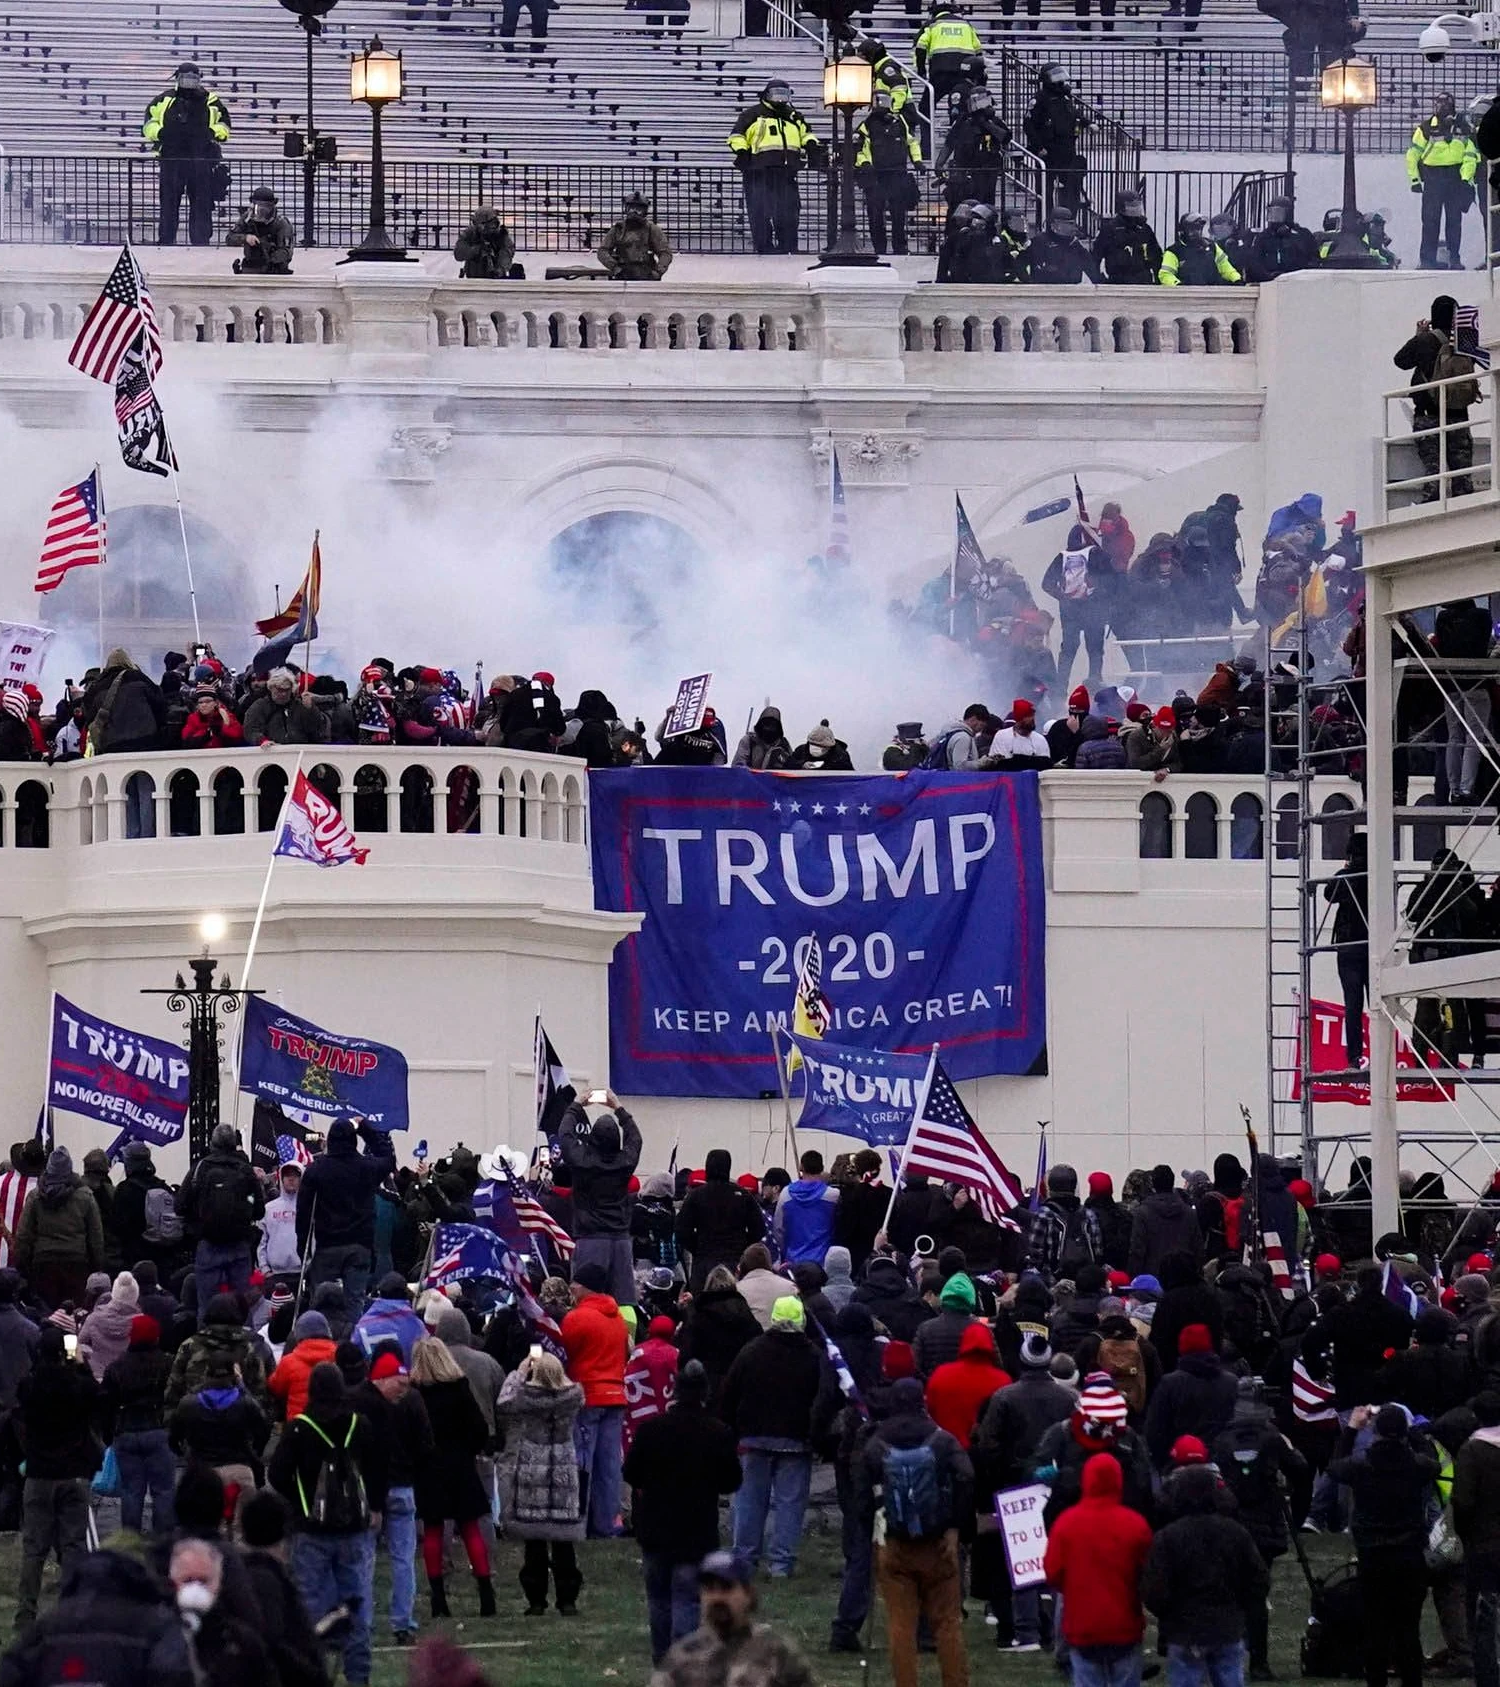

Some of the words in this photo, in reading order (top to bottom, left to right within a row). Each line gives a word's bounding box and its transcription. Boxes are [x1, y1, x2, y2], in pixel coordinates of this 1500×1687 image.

[940, 26, 963, 36] POLICE
[683, 677, 706, 728] TRUMP
[643, 811, 996, 908] TRUMP
[654, 1007, 730, 1034] KEEP
[903, 984, 1013, 1024] GREAT!
[61, 1011, 190, 1090] TRUMP
[267, 1026, 378, 1077] TRUMP
[54, 1080, 77, 1098] NO
[79, 1087, 124, 1111] MORE
[258, 1081, 289, 1096] KEEP
[291, 1092, 343, 1111] AMERICA
[871, 1111, 906, 1124] GREAT
[436, 1266, 475, 1287] KEEP
[1001, 1496, 1037, 1517] KEEP
[1009, 1531, 1028, 1546] TO
